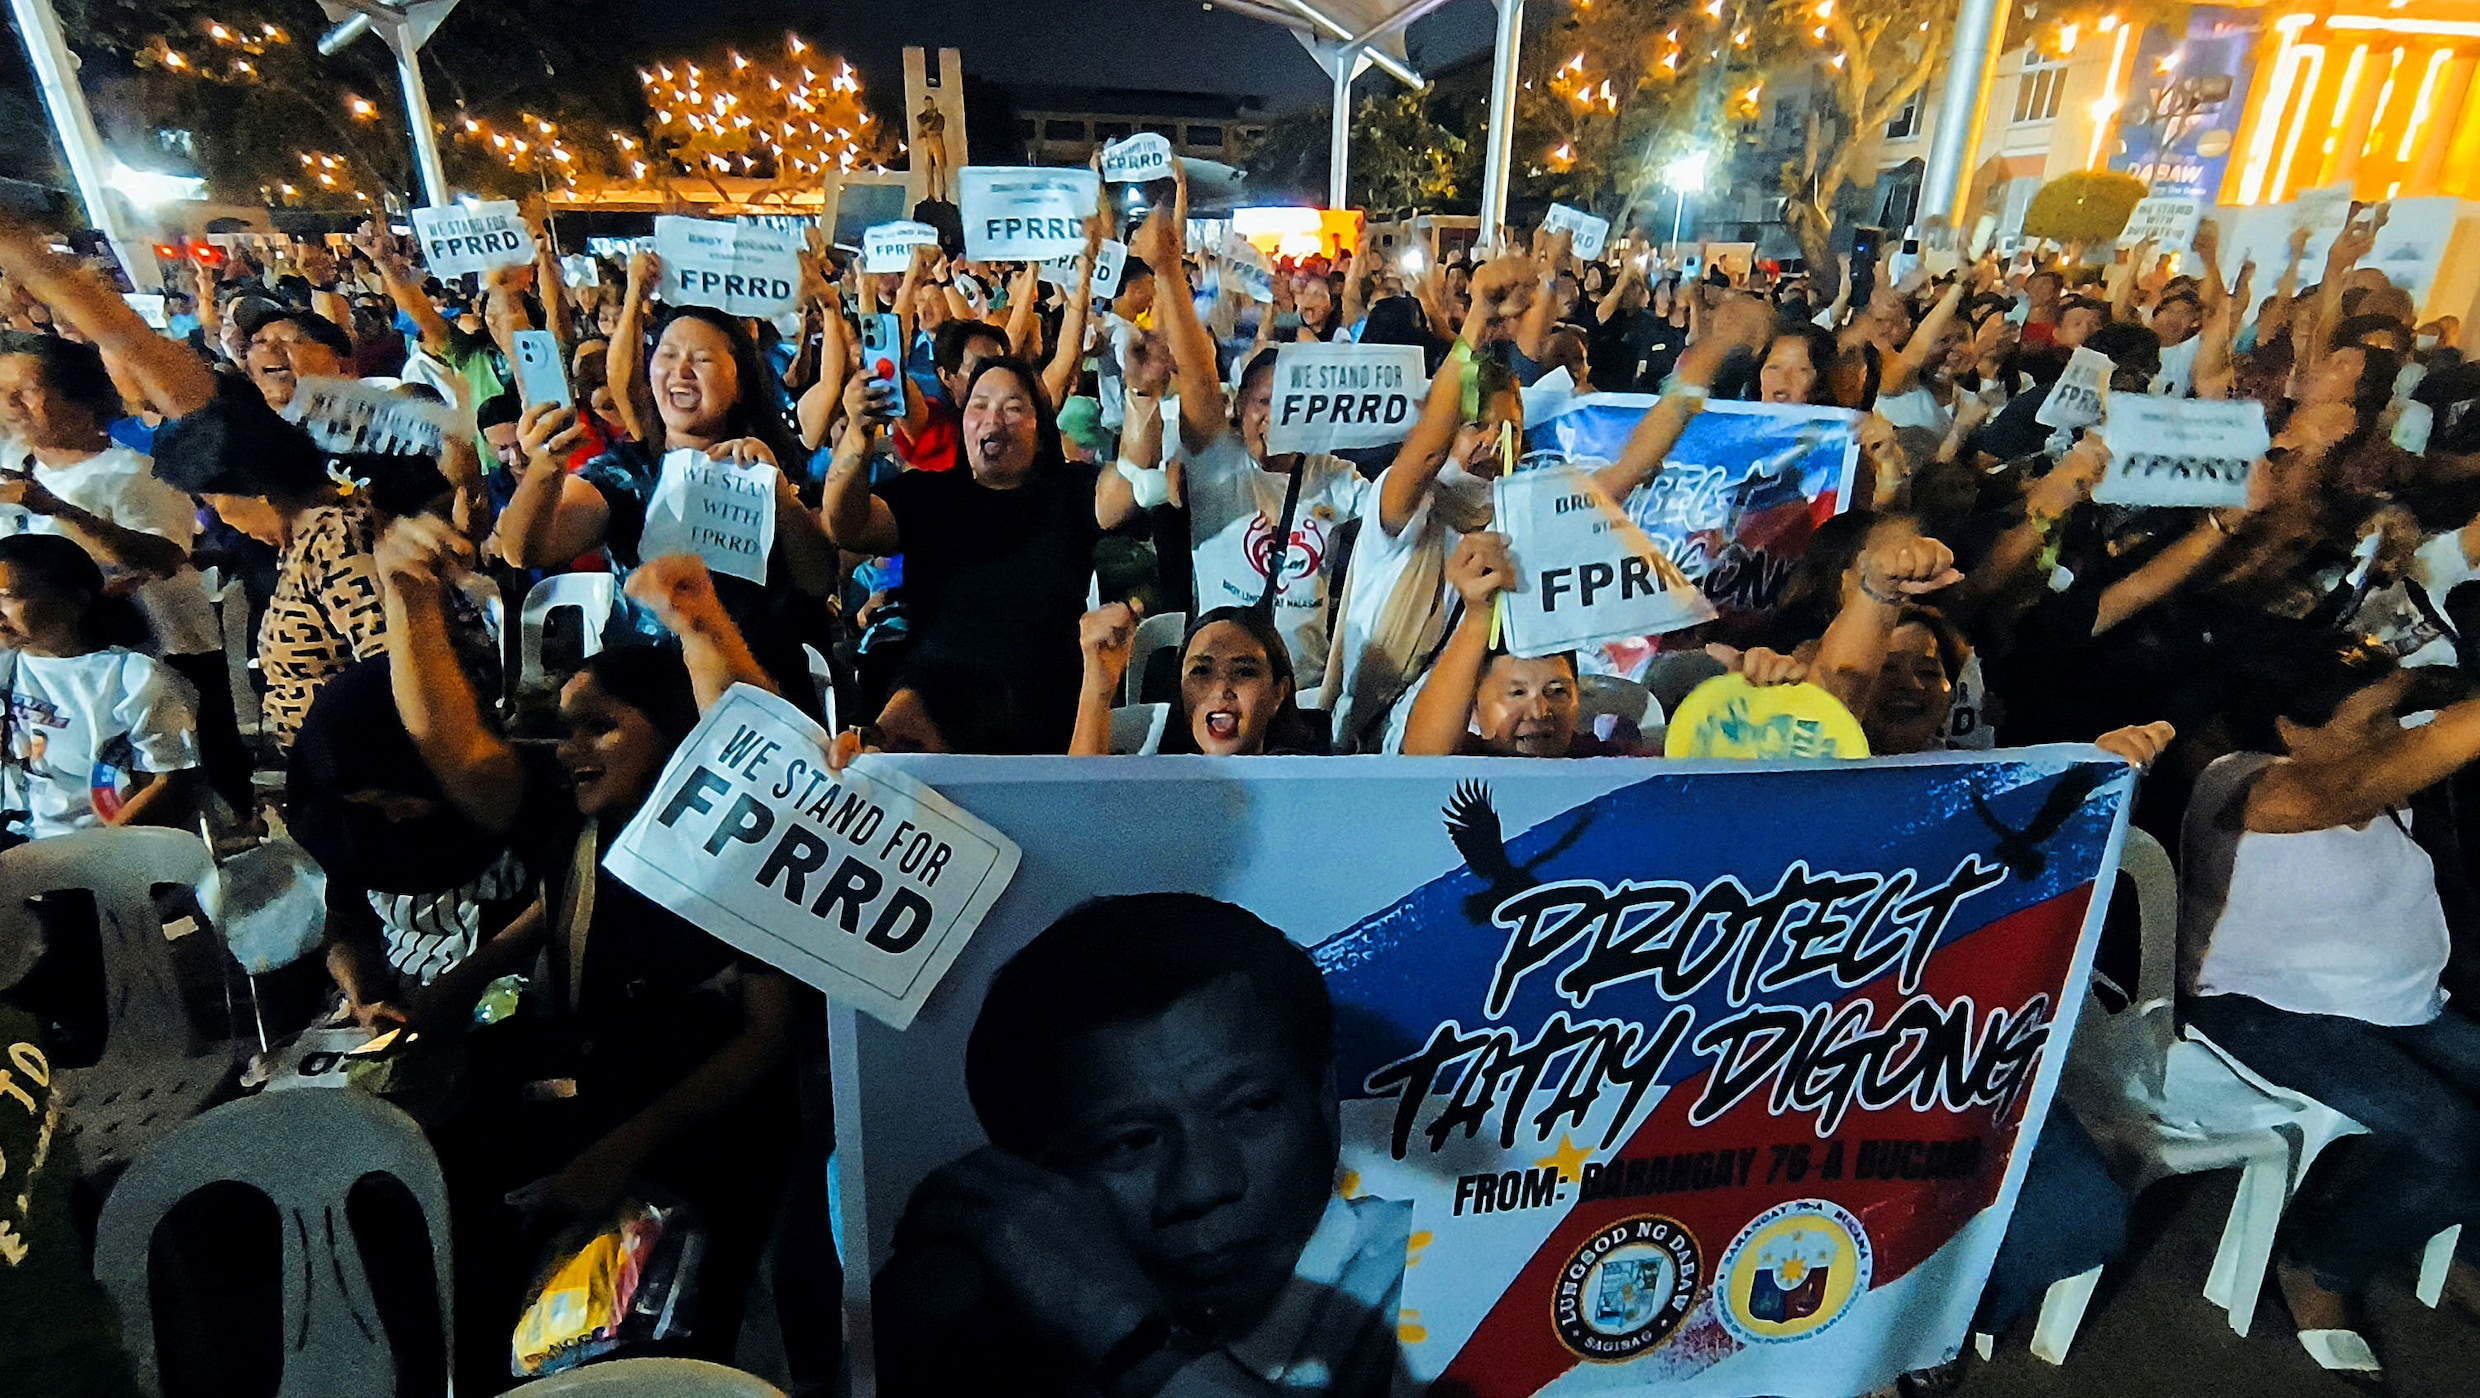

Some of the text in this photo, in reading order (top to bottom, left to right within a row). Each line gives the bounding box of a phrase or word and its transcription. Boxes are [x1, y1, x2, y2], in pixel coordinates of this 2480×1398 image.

[1107, 152, 1163, 169] FPRRD
[427, 215, 509, 236] WE STAND FOR
[430, 231, 520, 259] FPRRD
[680, 269, 791, 299] FPRRD
[1290, 365, 1403, 388] WE STAND FOR
[1281, 394, 1408, 426] FPRRD
[683, 467, 716, 485] WE
[702, 498, 760, 527] WITH
[691, 526, 759, 555] FPRRD
[717, 724, 952, 888] WE STAND FOR
[657, 765, 934, 955] FPRRD
[1486, 854, 2009, 1020] PROTECT
[1363, 994, 2052, 1161] TATAY DIGONG
[1452, 1165, 1568, 1217] FROM:
[1579, 1145, 1761, 1202] BARANGAY
[1765, 1141, 1845, 1184] 76-A
[1560, 1227, 1629, 1326] LUNGSOD
[1636, 1222, 1669, 1241] NG
